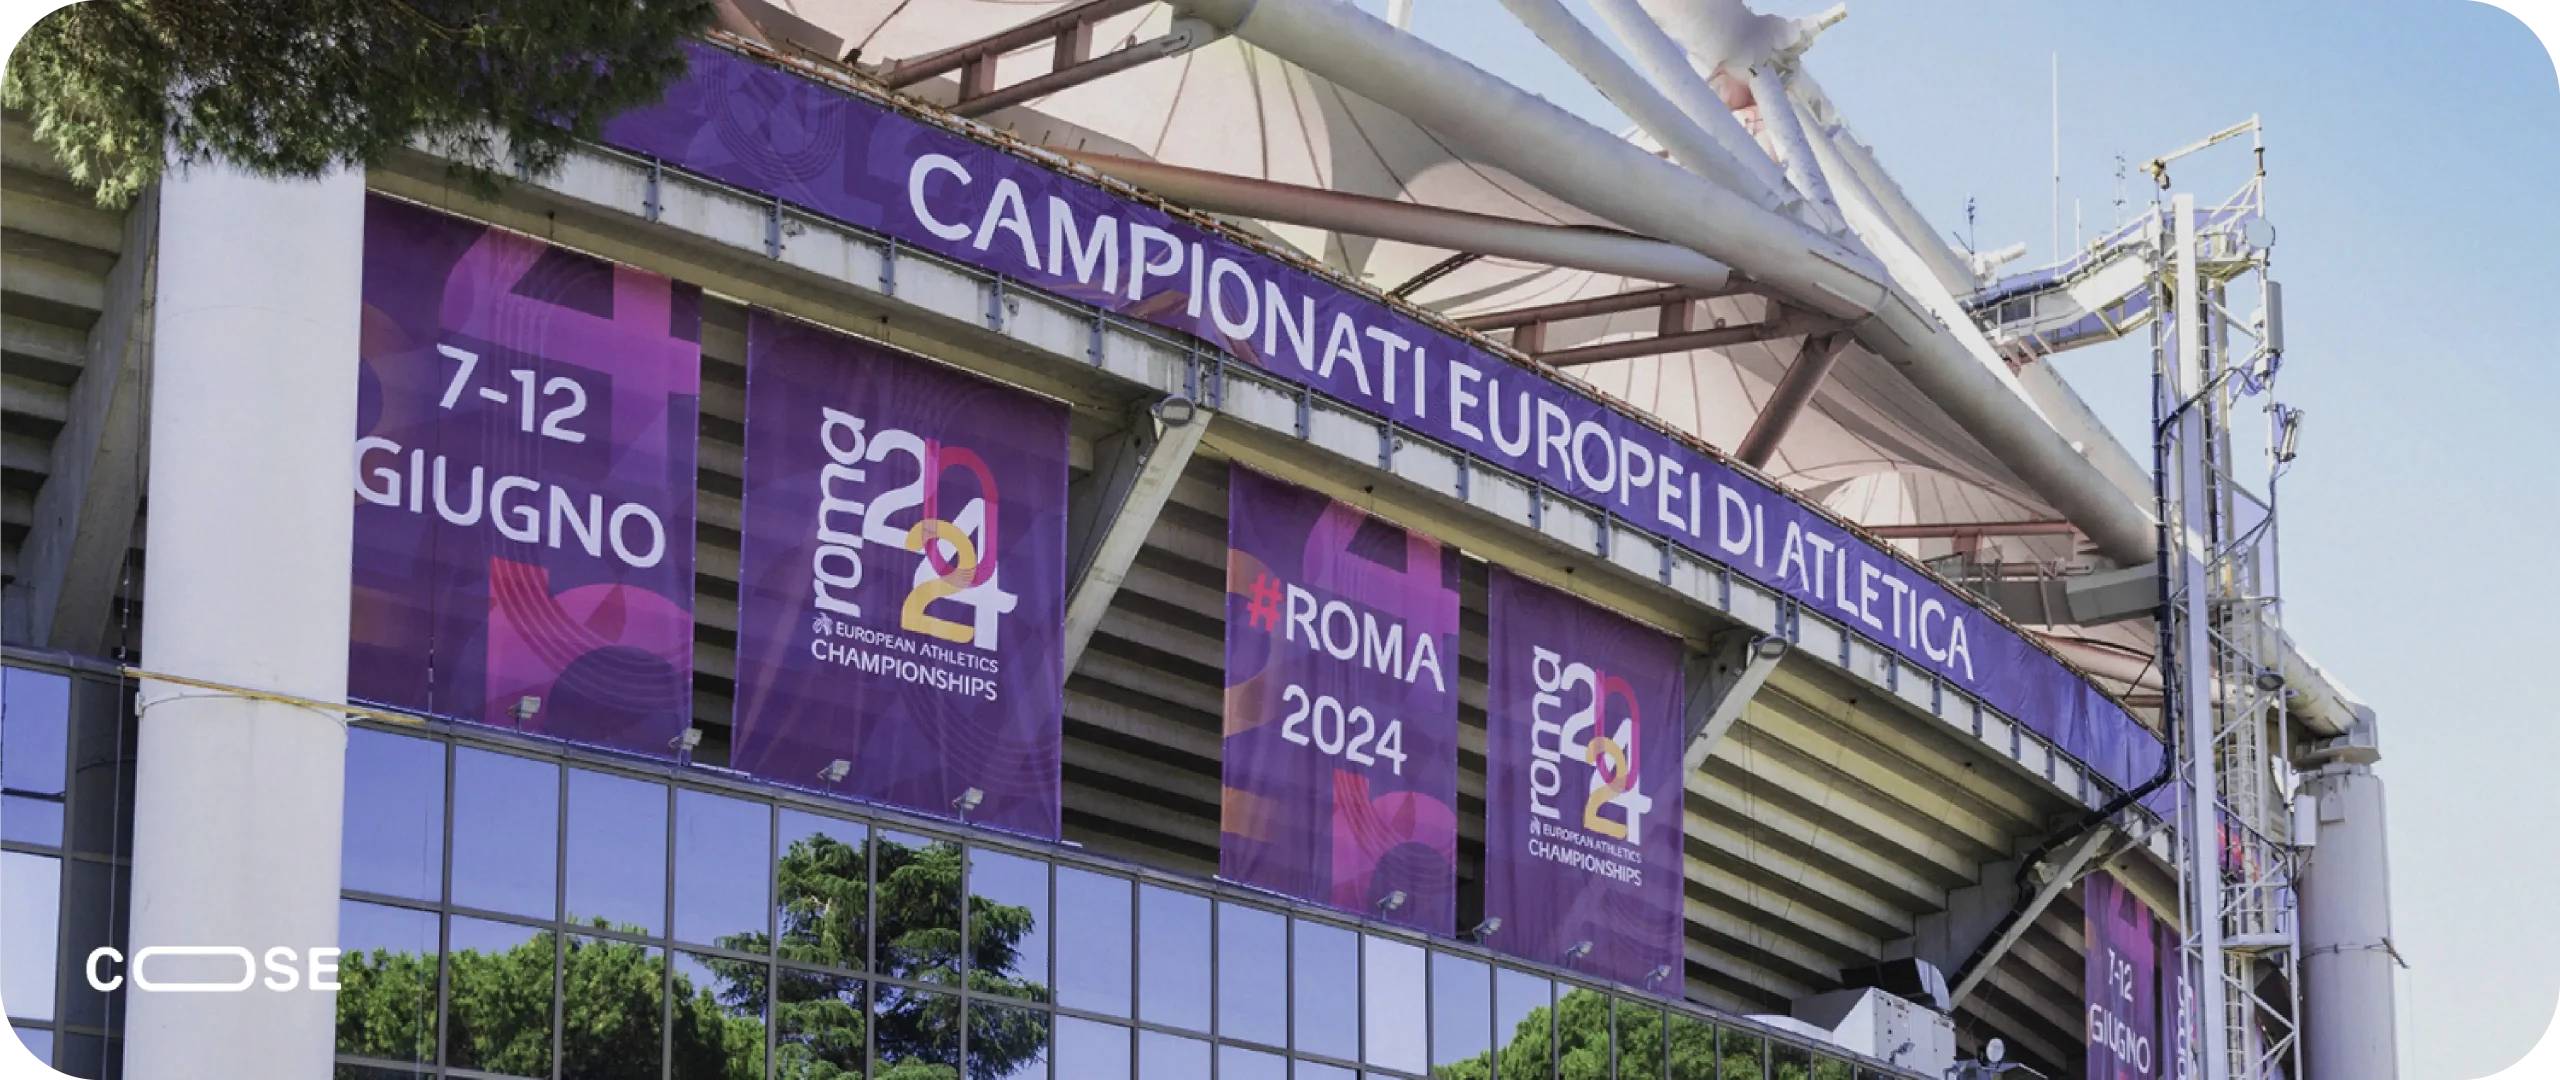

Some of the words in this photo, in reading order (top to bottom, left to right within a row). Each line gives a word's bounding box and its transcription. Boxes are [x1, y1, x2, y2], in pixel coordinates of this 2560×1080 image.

[437, 343, 587, 443] 7-12
[909, 154, 1425, 419] CAMPIONATI
[1450, 359, 1699, 536] EUROPEI
[1718, 483, 1764, 568] DI
[1778, 520, 1975, 681] ATLETICA
[354, 437, 666, 568] GIUGNO
[813, 406, 866, 617] roma
[811, 639, 998, 701] CHAMPIONSHIPS
[836, 622, 916, 655] EUROPEAN
[920, 643, 1000, 674] ATHLETICS
[1247, 574, 1446, 692] #ROMA
[1282, 684, 1408, 775] 2024
[1529, 645, 1561, 820] roma
[1528, 839, 1643, 887] CHAMPIONSHIPS
[1543, 823, 1595, 849] EUROPEAN
[1594, 840, 1642, 864] ATHLETICS
[2108, 949, 2134, 1001] 7-12
[2090, 1003, 2151, 1073] GIUGNO
